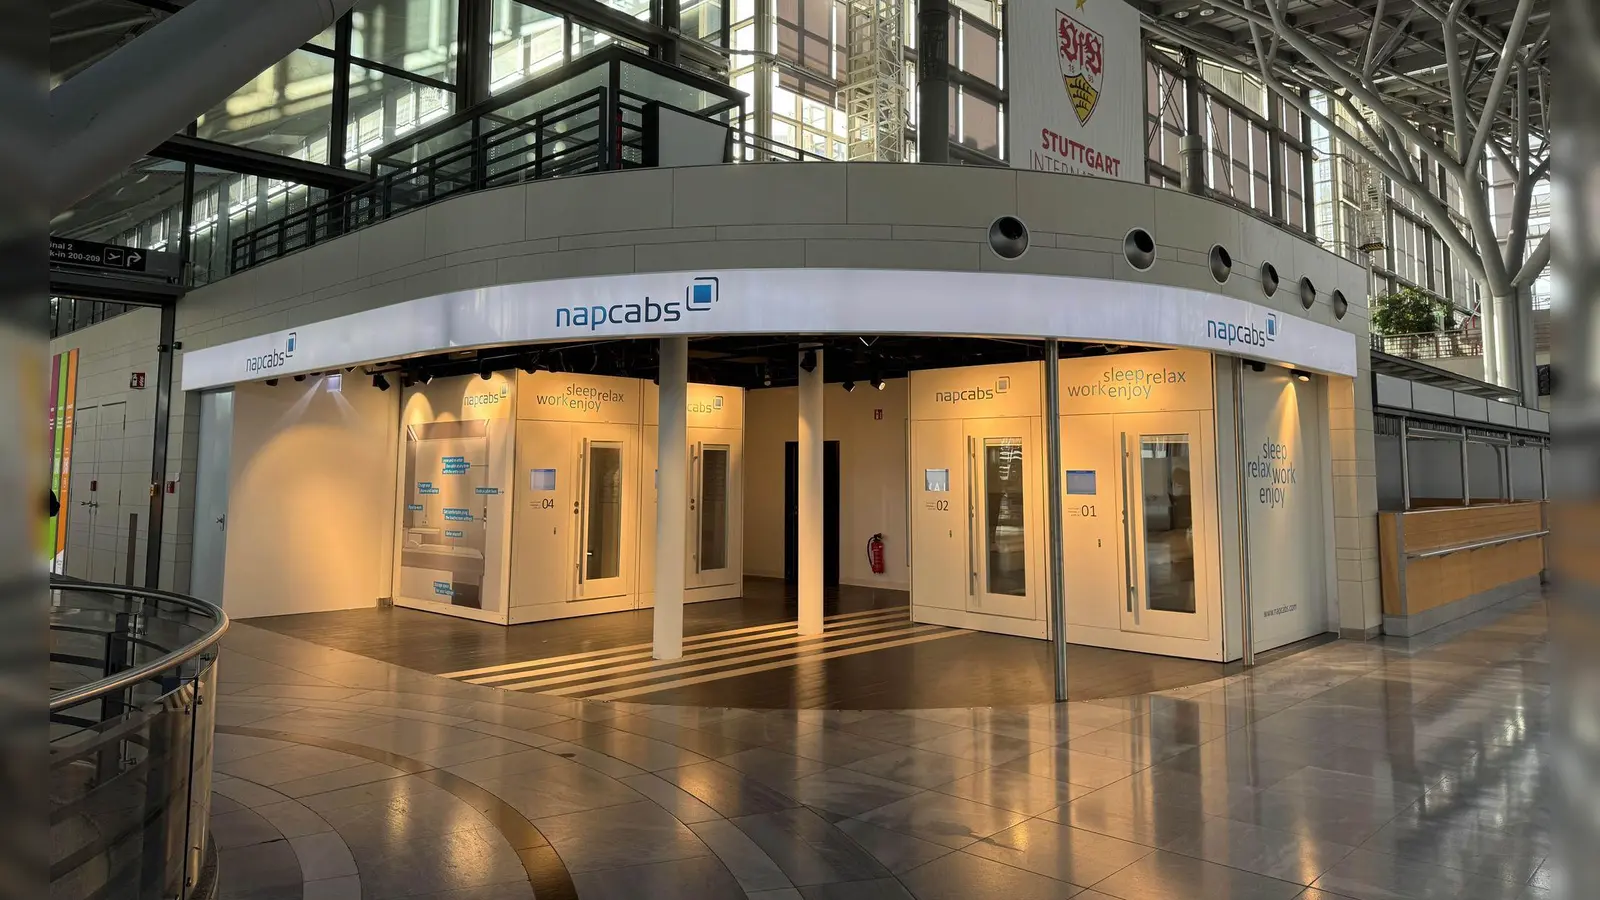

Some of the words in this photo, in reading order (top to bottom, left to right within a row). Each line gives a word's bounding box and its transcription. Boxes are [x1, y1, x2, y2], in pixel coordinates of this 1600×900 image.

[1042, 128, 1120, 177] STUTTGART
[67, 243, 73, 251] 2
[68, 252, 100, 262] 200-209
[555, 297, 681, 330] napcabs
[1207, 320, 1266, 347] napcabs
[246, 348, 285, 374] napcabs
[1103, 367, 1144, 383] sleep
[1146, 368, 1186, 385] relax
[463, 391, 499, 407] napcabs
[566, 383, 597, 399] sleep
[598, 389, 624, 402] relax
[935, 386, 994, 404] napcabs
[1067, 380, 1107, 397] work
[1108, 382, 1151, 400] enjoy
[536, 393, 569, 406] work
[569, 397, 601, 412] enjoy
[1263, 437, 1287, 460] sleep
[1247, 456, 1271, 478] relax
[1272, 462, 1296, 484] work
[541, 498, 554, 509] 04
[1259, 482, 1285, 508] enjoy
[936, 500, 949, 511] 02
[1081, 504, 1097, 517] 01
